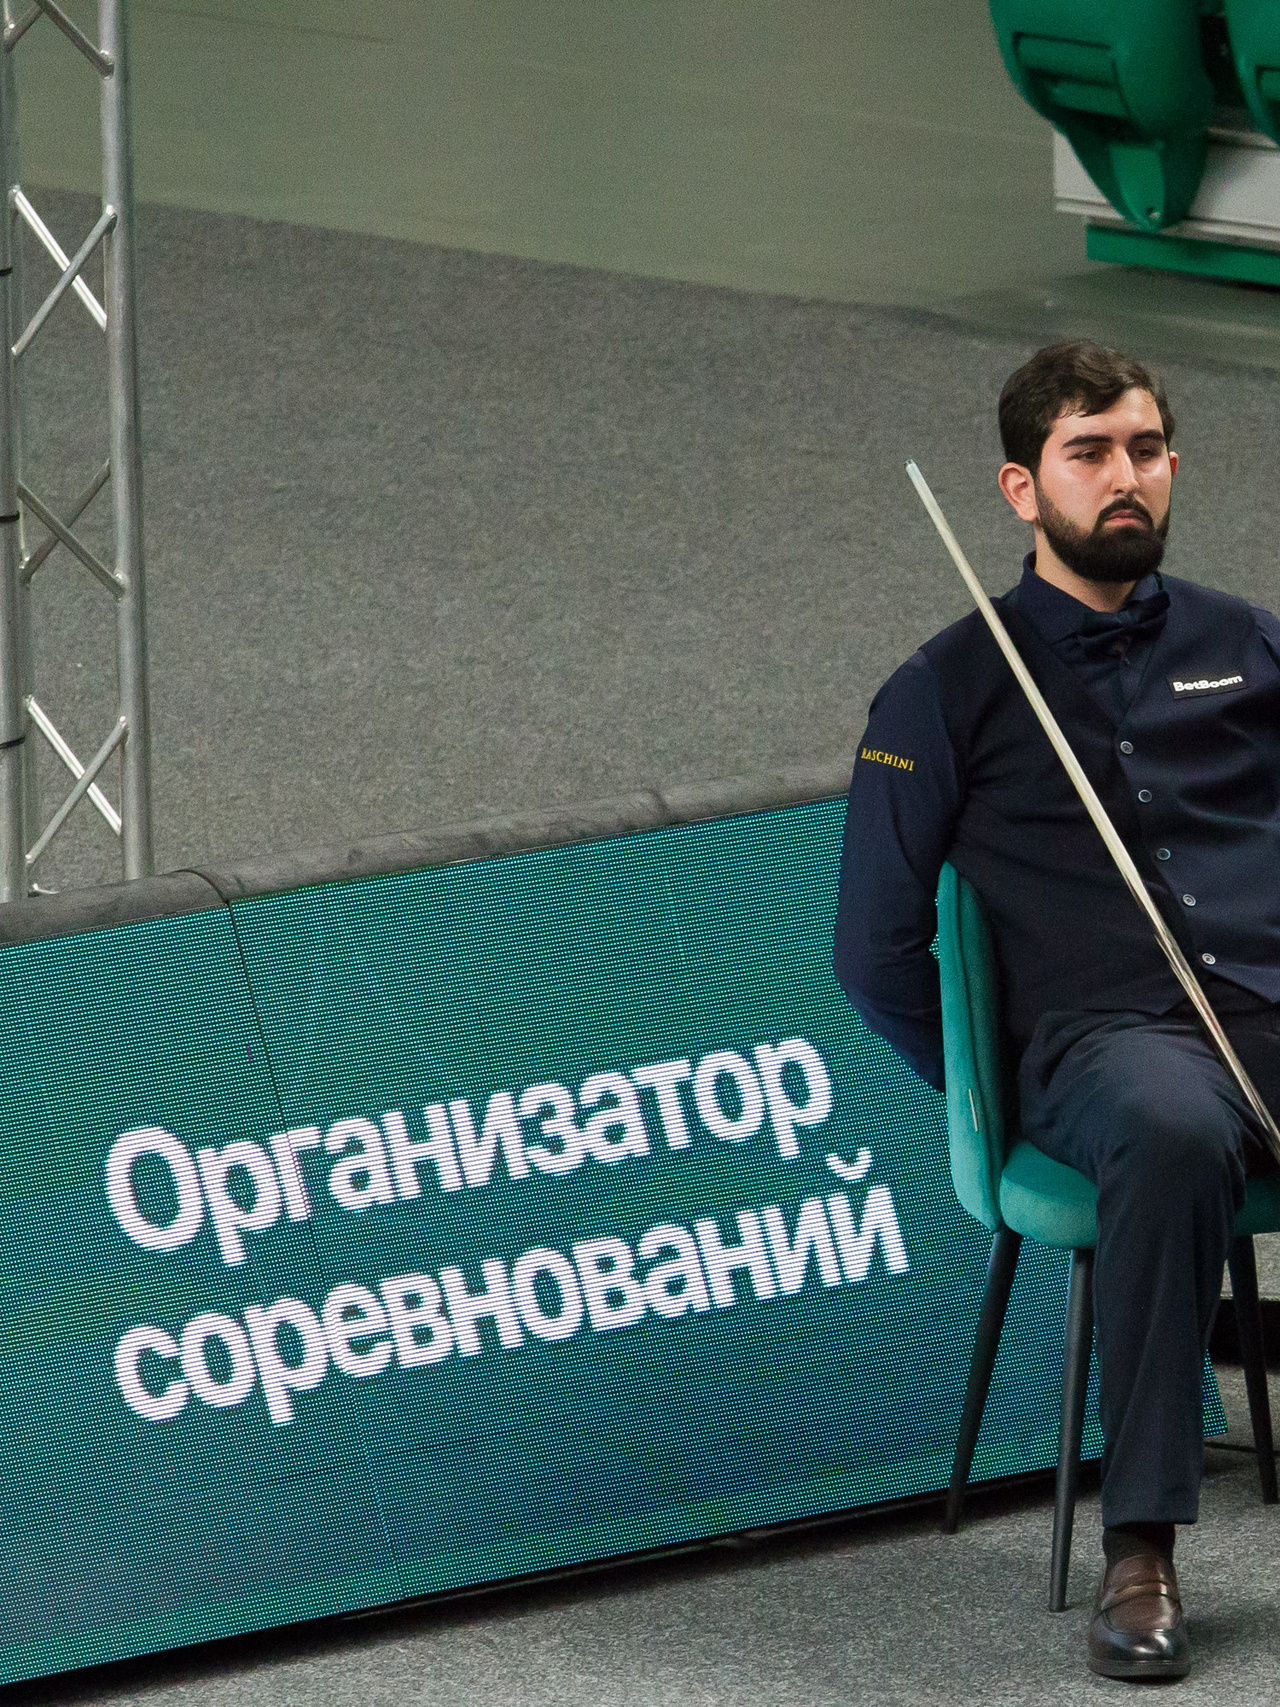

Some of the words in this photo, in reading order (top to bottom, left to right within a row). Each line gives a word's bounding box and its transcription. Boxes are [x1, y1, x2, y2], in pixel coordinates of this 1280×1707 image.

[1172, 675, 1244, 692] BetBoom
[104, 1036, 834, 1267] Организатор
[114, 1147, 910, 1428] соревнований
